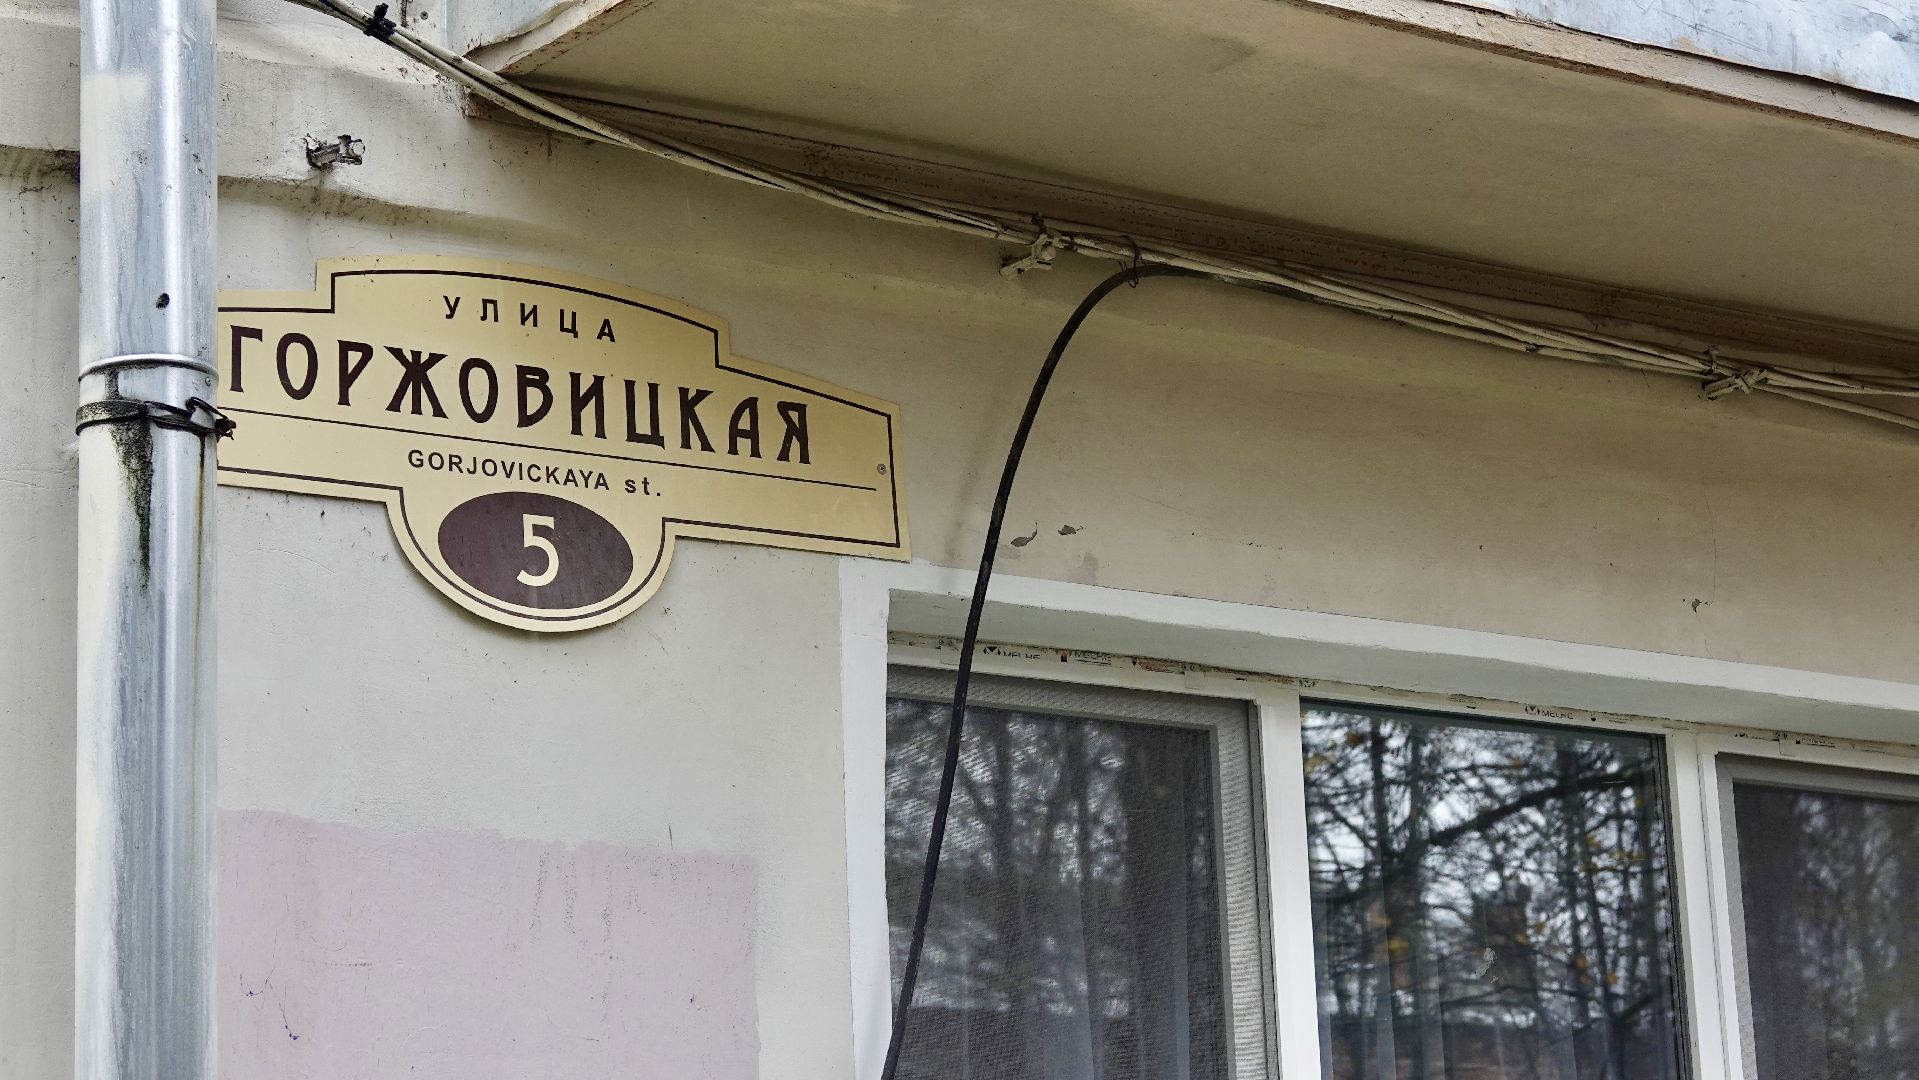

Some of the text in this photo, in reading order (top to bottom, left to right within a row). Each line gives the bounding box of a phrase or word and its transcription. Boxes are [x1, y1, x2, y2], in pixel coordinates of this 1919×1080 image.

[442, 295, 616, 343] УЛИЦА
[229, 324, 811, 465] ГОРЖОВИЦКАЯ
[407, 449, 662, 497] GORJOVICKAYA st.
[516, 513, 560, 587] 5
